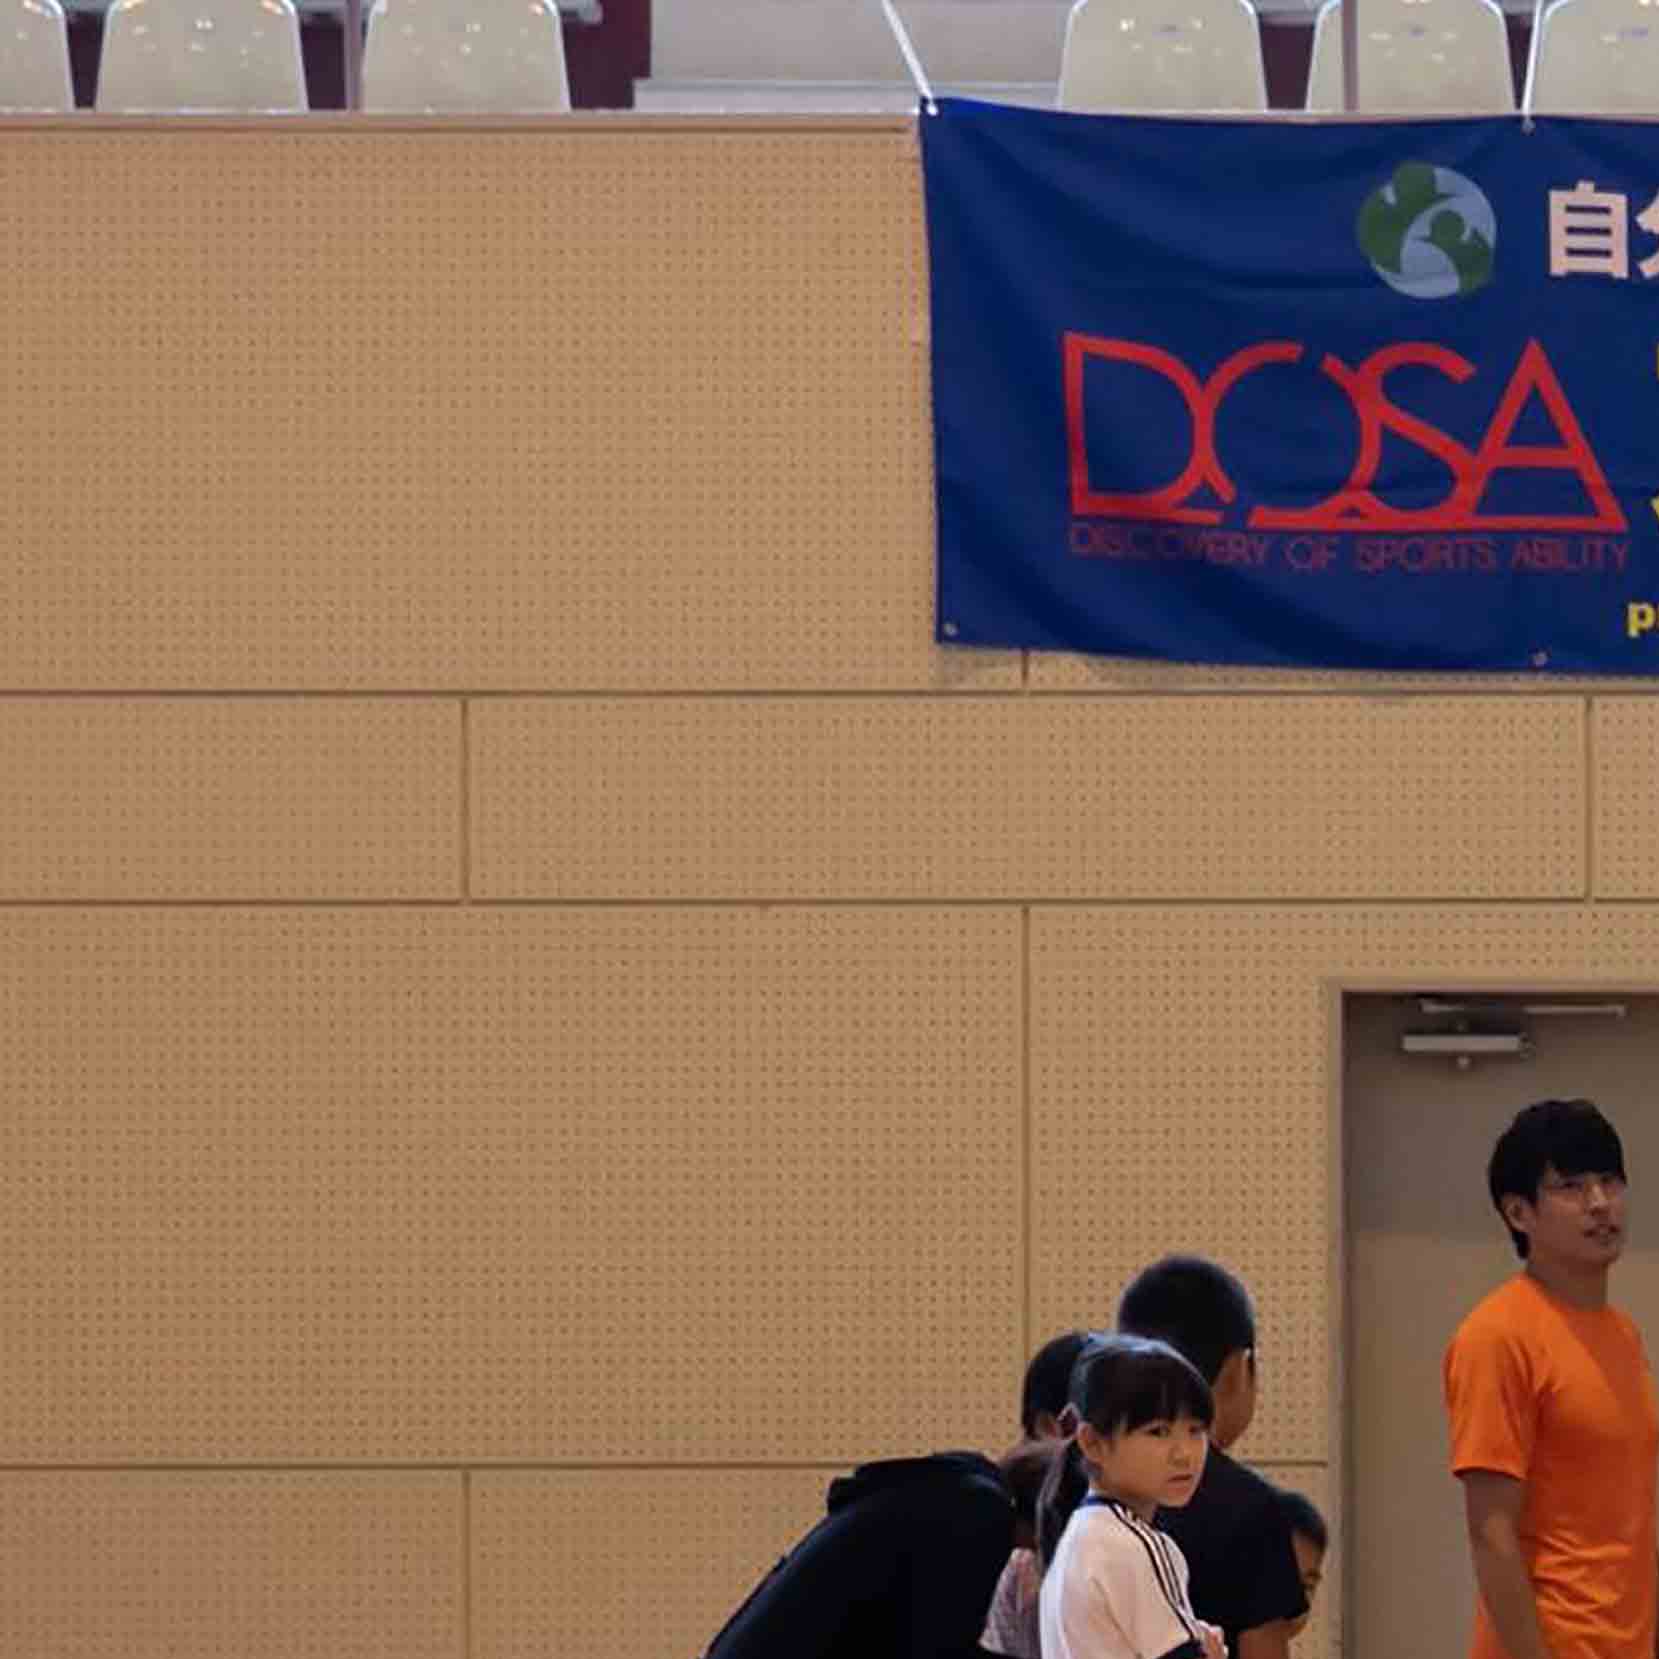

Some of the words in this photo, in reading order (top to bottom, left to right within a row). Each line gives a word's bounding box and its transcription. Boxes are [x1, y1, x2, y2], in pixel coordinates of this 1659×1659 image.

[1284, 535, 1338, 571] OF
[1357, 535, 1497, 573] SPORTS
[1511, 536, 1630, 571] ABILITY
